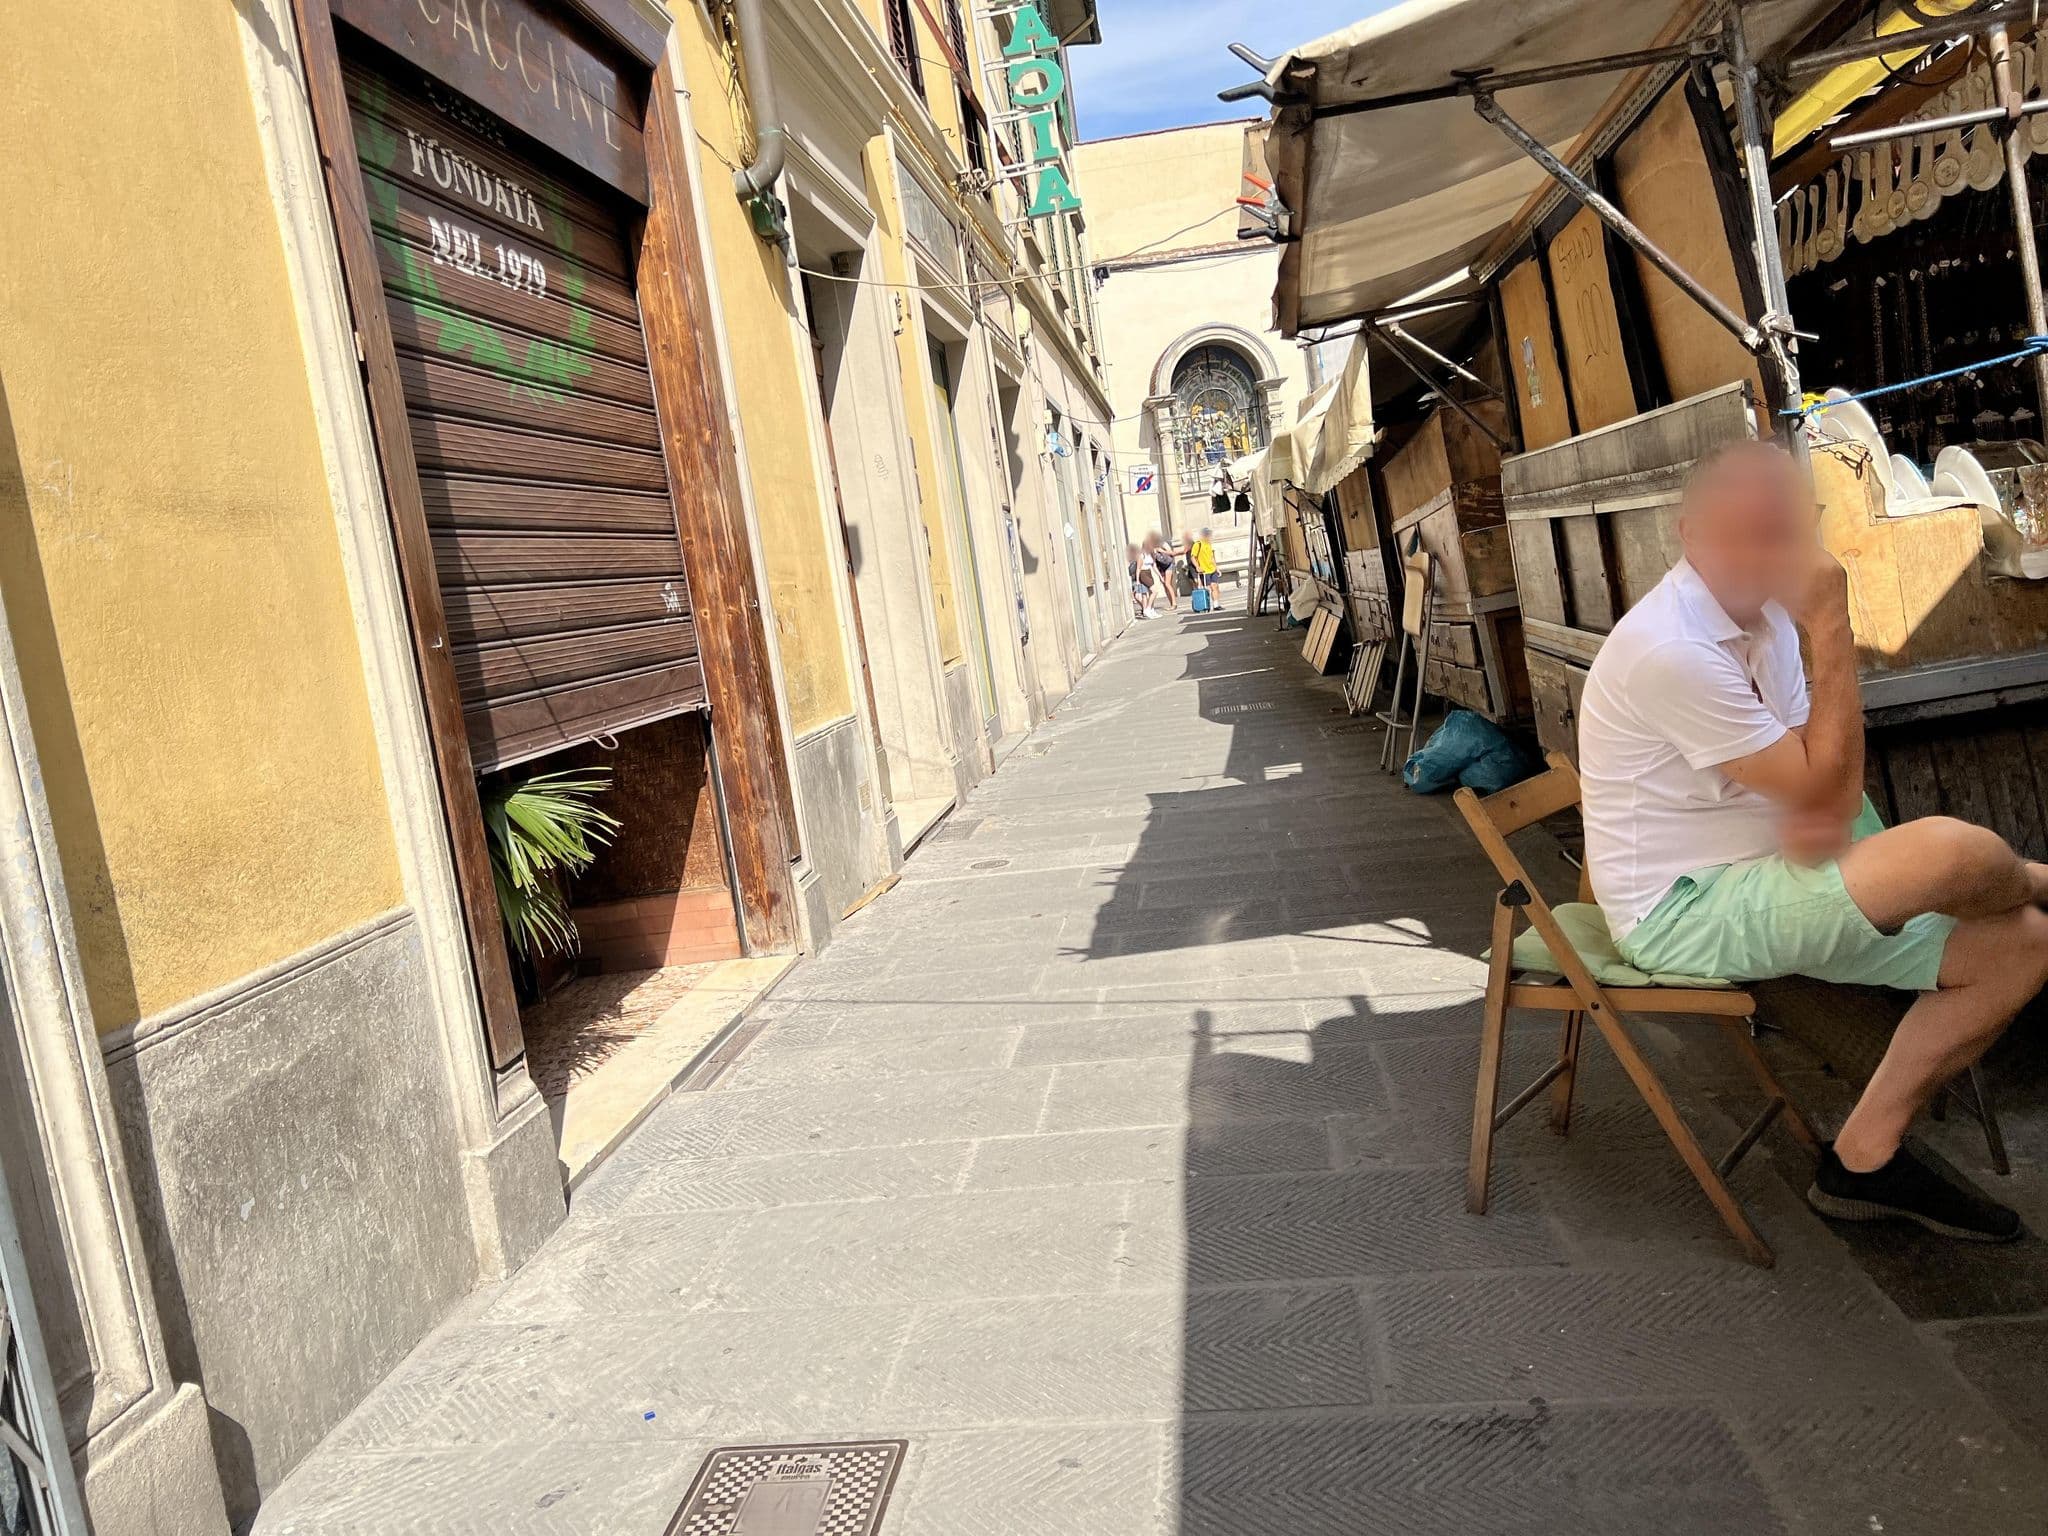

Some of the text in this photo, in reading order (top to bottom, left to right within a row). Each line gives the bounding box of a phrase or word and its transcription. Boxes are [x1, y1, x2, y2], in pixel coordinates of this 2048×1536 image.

[427, 215, 548, 299] NEL 1979
[775, 1463, 823, 1475] Italgas
